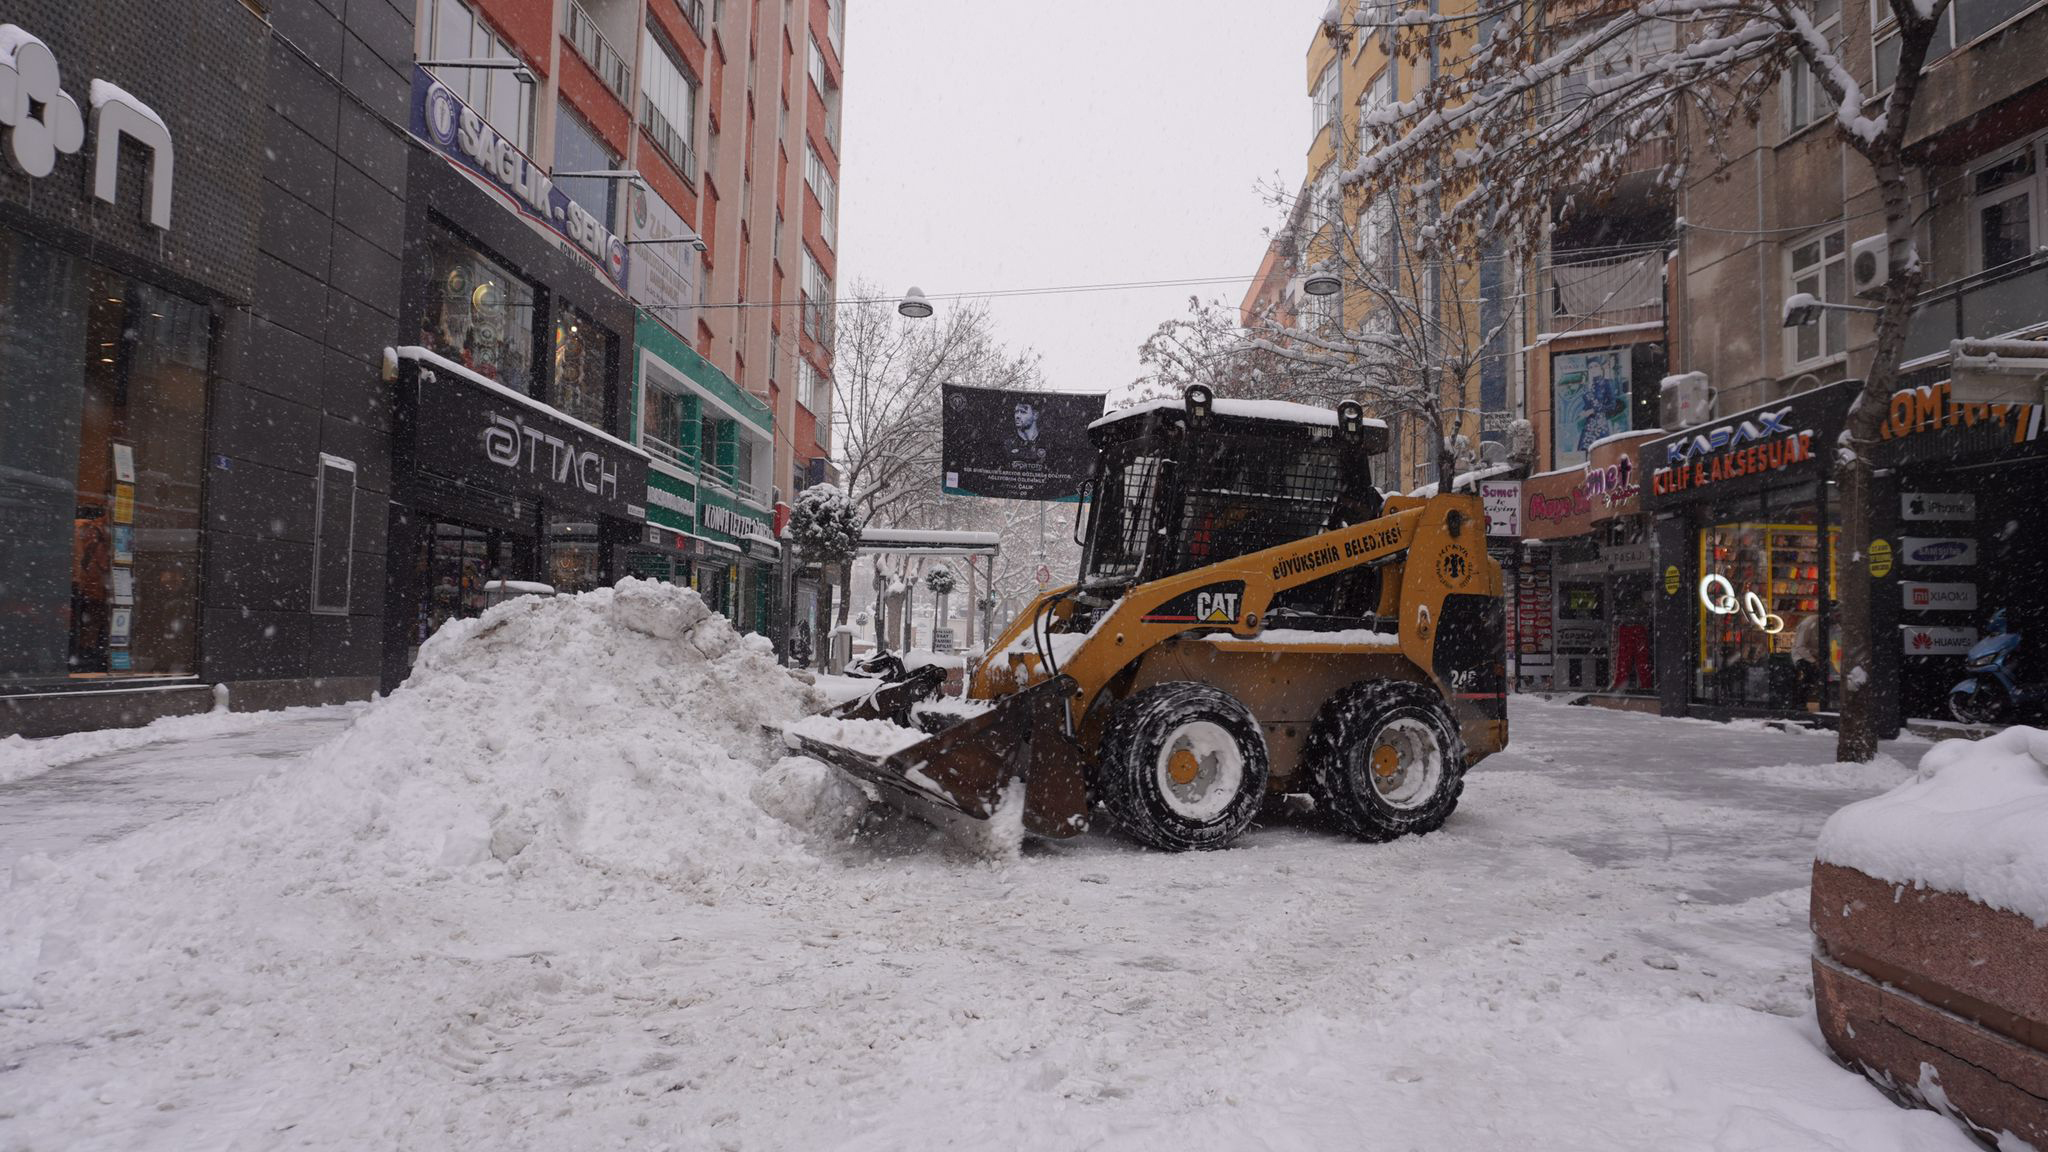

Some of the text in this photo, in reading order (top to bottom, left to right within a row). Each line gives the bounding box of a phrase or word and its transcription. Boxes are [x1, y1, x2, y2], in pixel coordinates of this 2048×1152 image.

[1666, 405, 1793, 464] KAPAX
[1652, 431, 1817, 496] KILIF & AKSESUAR
[1482, 485, 1519, 498] Samet
[1927, 501, 1966, 513] iPhone
[704, 503, 730, 535] KONYA
[1272, 543, 1340, 580] BÜYÜKŞEHİR
[1196, 591, 1238, 622] CAT
[1930, 591, 1969, 601] XIAOMI
